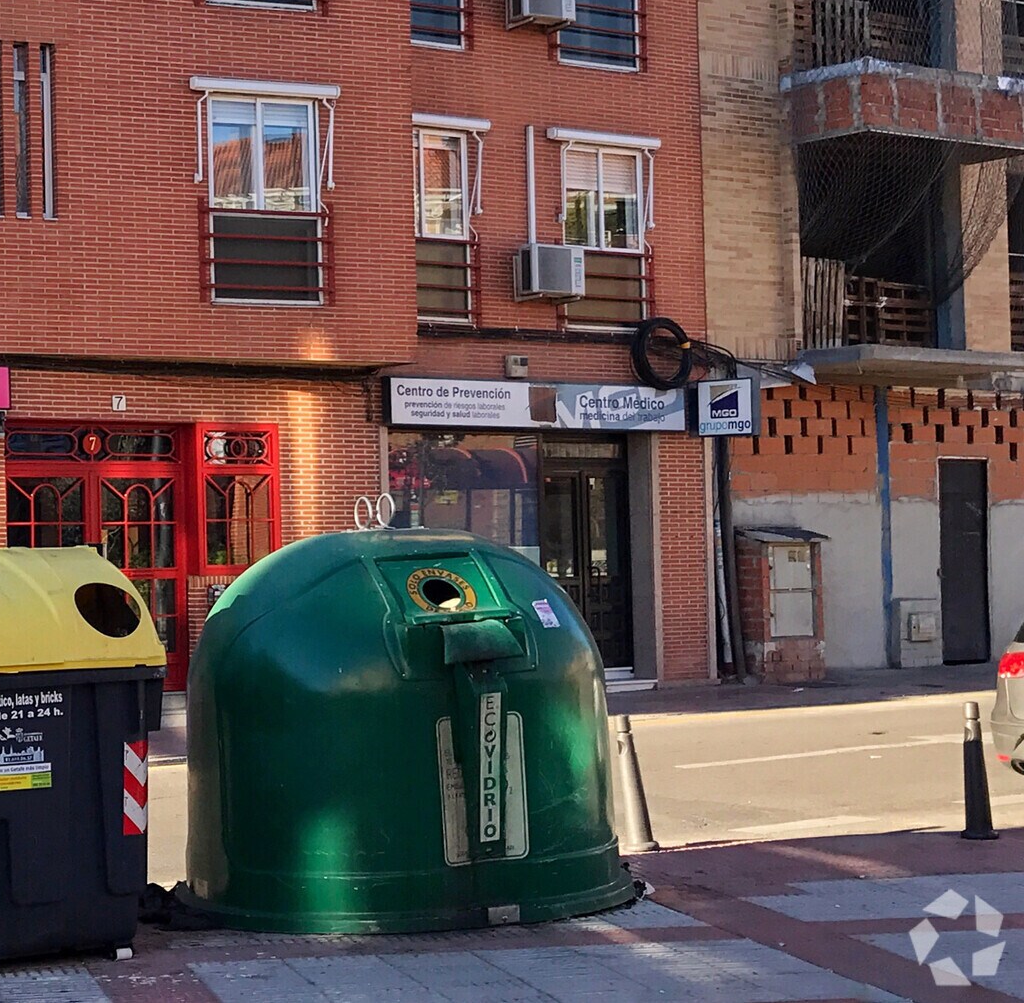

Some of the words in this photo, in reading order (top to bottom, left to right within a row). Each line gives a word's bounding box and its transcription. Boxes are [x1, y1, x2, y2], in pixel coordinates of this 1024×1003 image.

[396, 384, 433, 397] Centro
[436, 386, 449, 397] de
[452, 386, 511, 399] Prevención
[114, 396, 124, 410] 7
[404, 400, 443, 409] prevención
[443, 401, 452, 409] de
[454, 401, 476, 411] riesgos
[477, 402, 505, 411] laborales
[579, 395, 619, 408] Centro
[623, 396, 665, 410] Médico
[411, 409, 445, 419] seguridad
[446, 411, 450, 419] y
[452, 410, 471, 418] salud
[472, 410, 500, 419] laborales
[580, 411, 620, 421] medicina
[622, 411, 635, 421] del
[637, 412, 666, 424] trabajo
[711, 408, 737, 418] MGO
[699, 420, 751, 434] grupomgo
[15, 693, 33, 706] latas
[34, 695, 40, 707] y
[40, 691, 63, 704] bricks
[11, 710, 23, 719] 21
[27, 711, 34, 719] a
[37, 708, 51, 717] 24
[53, 707, 64, 716] h.
